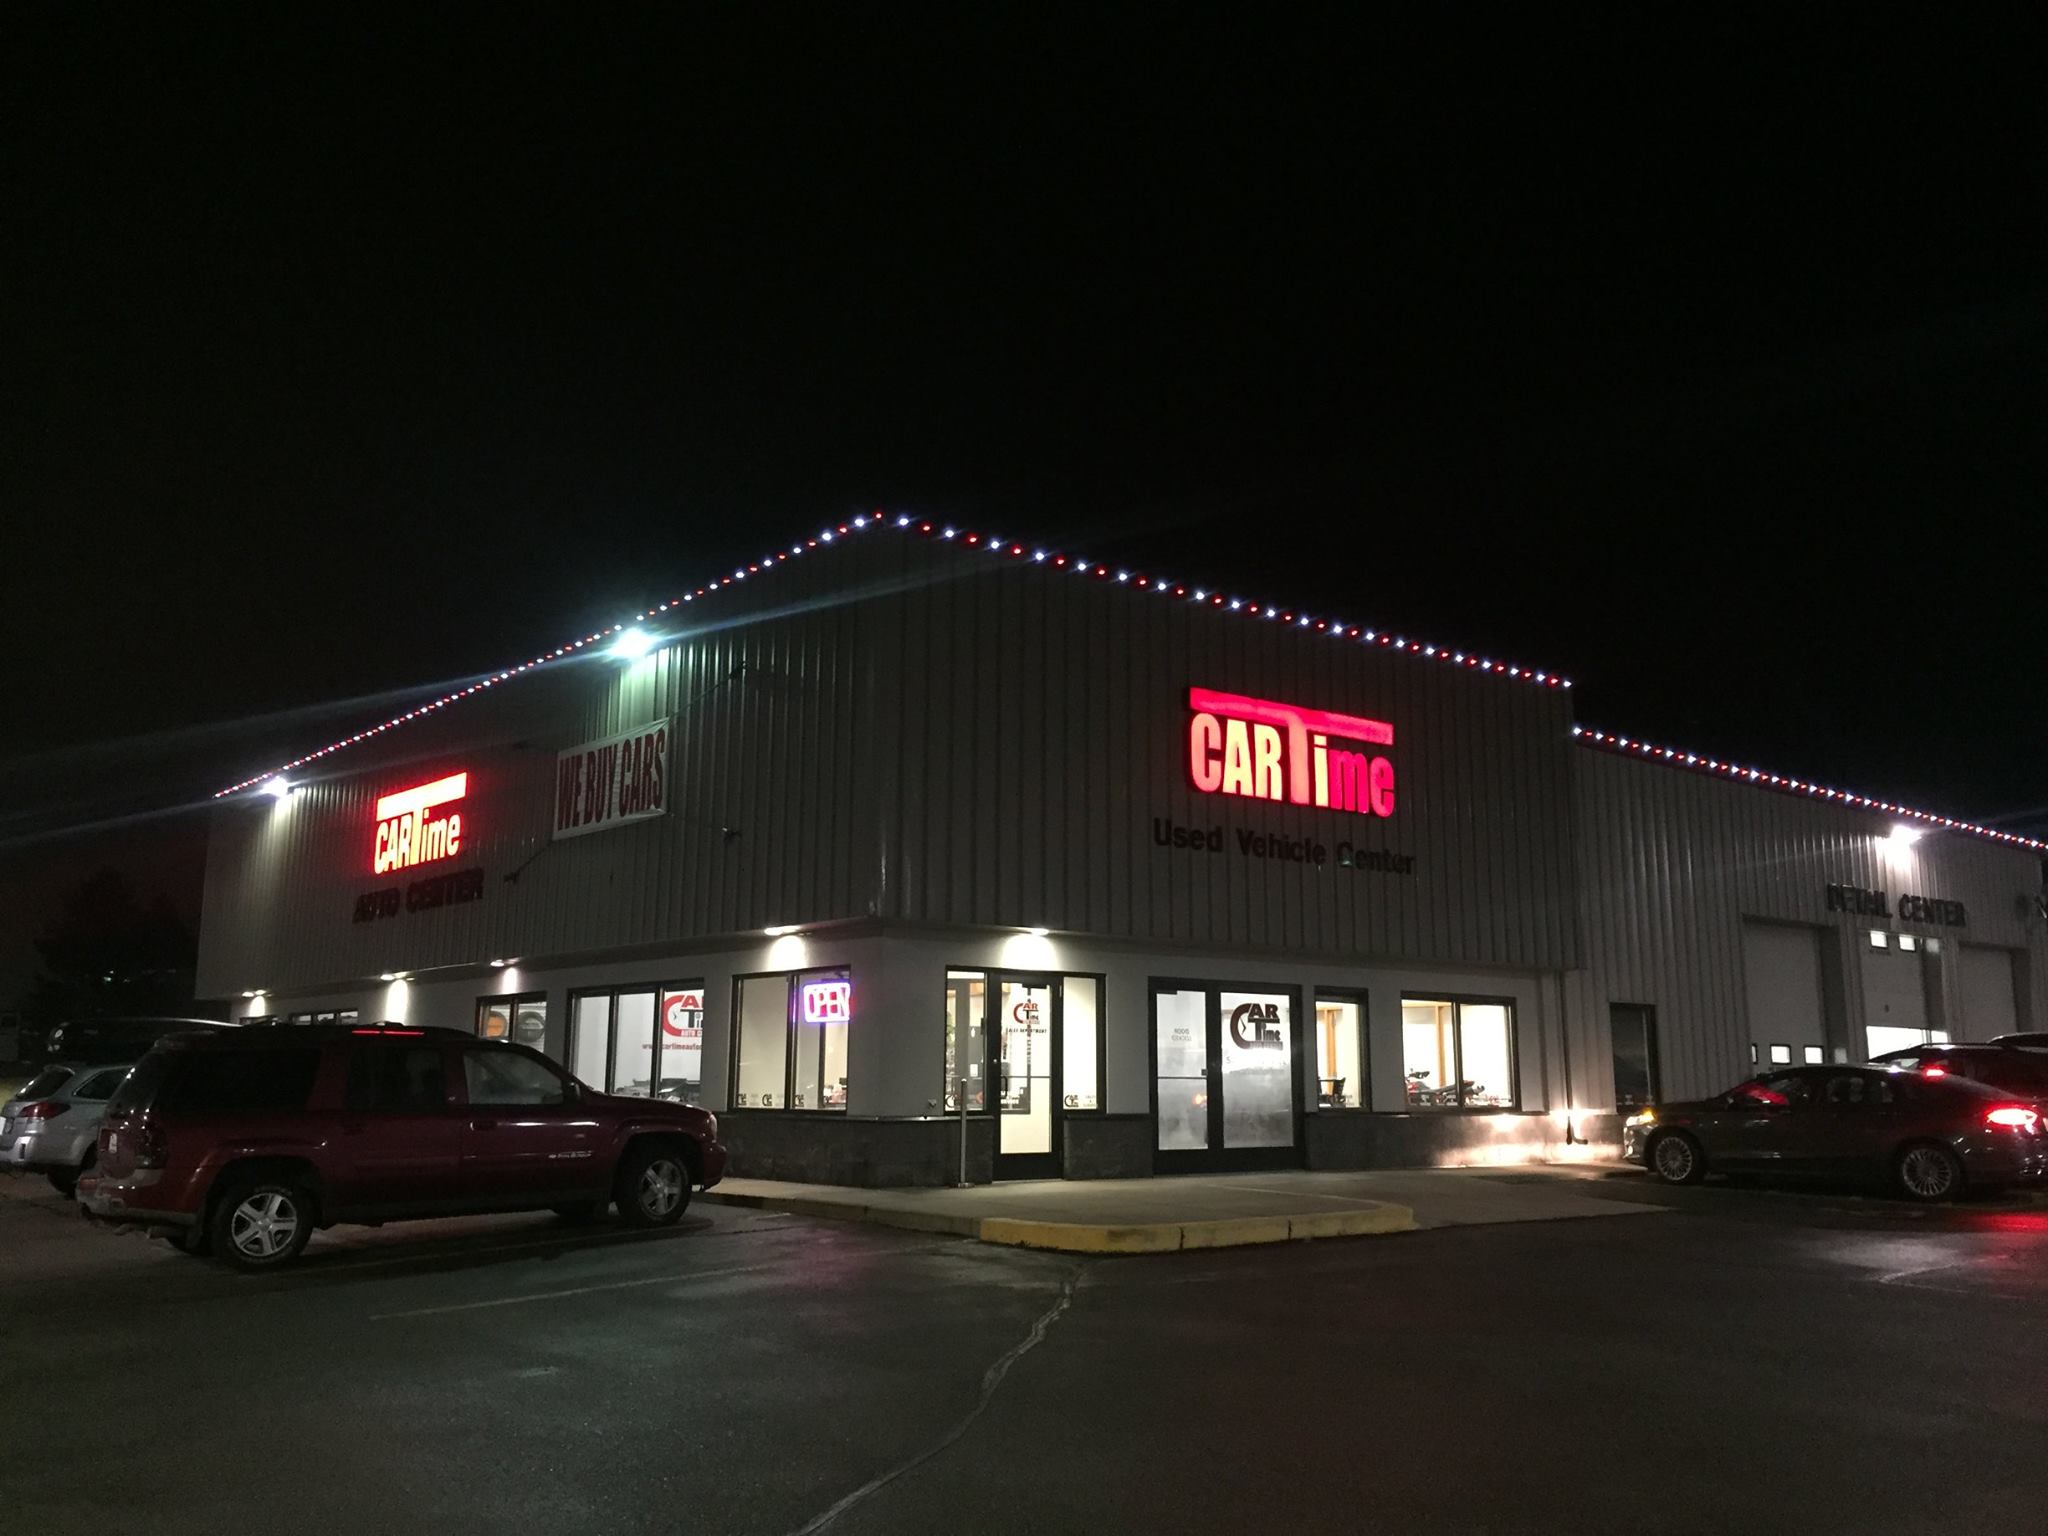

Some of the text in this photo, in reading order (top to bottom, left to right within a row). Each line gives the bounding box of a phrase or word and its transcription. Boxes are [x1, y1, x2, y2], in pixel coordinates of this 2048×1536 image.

[557, 728, 666, 831] WE BUY CARS
[1153, 817, 1417, 875] Used Vehicle Center
[806, 987, 849, 1018] OPEN
